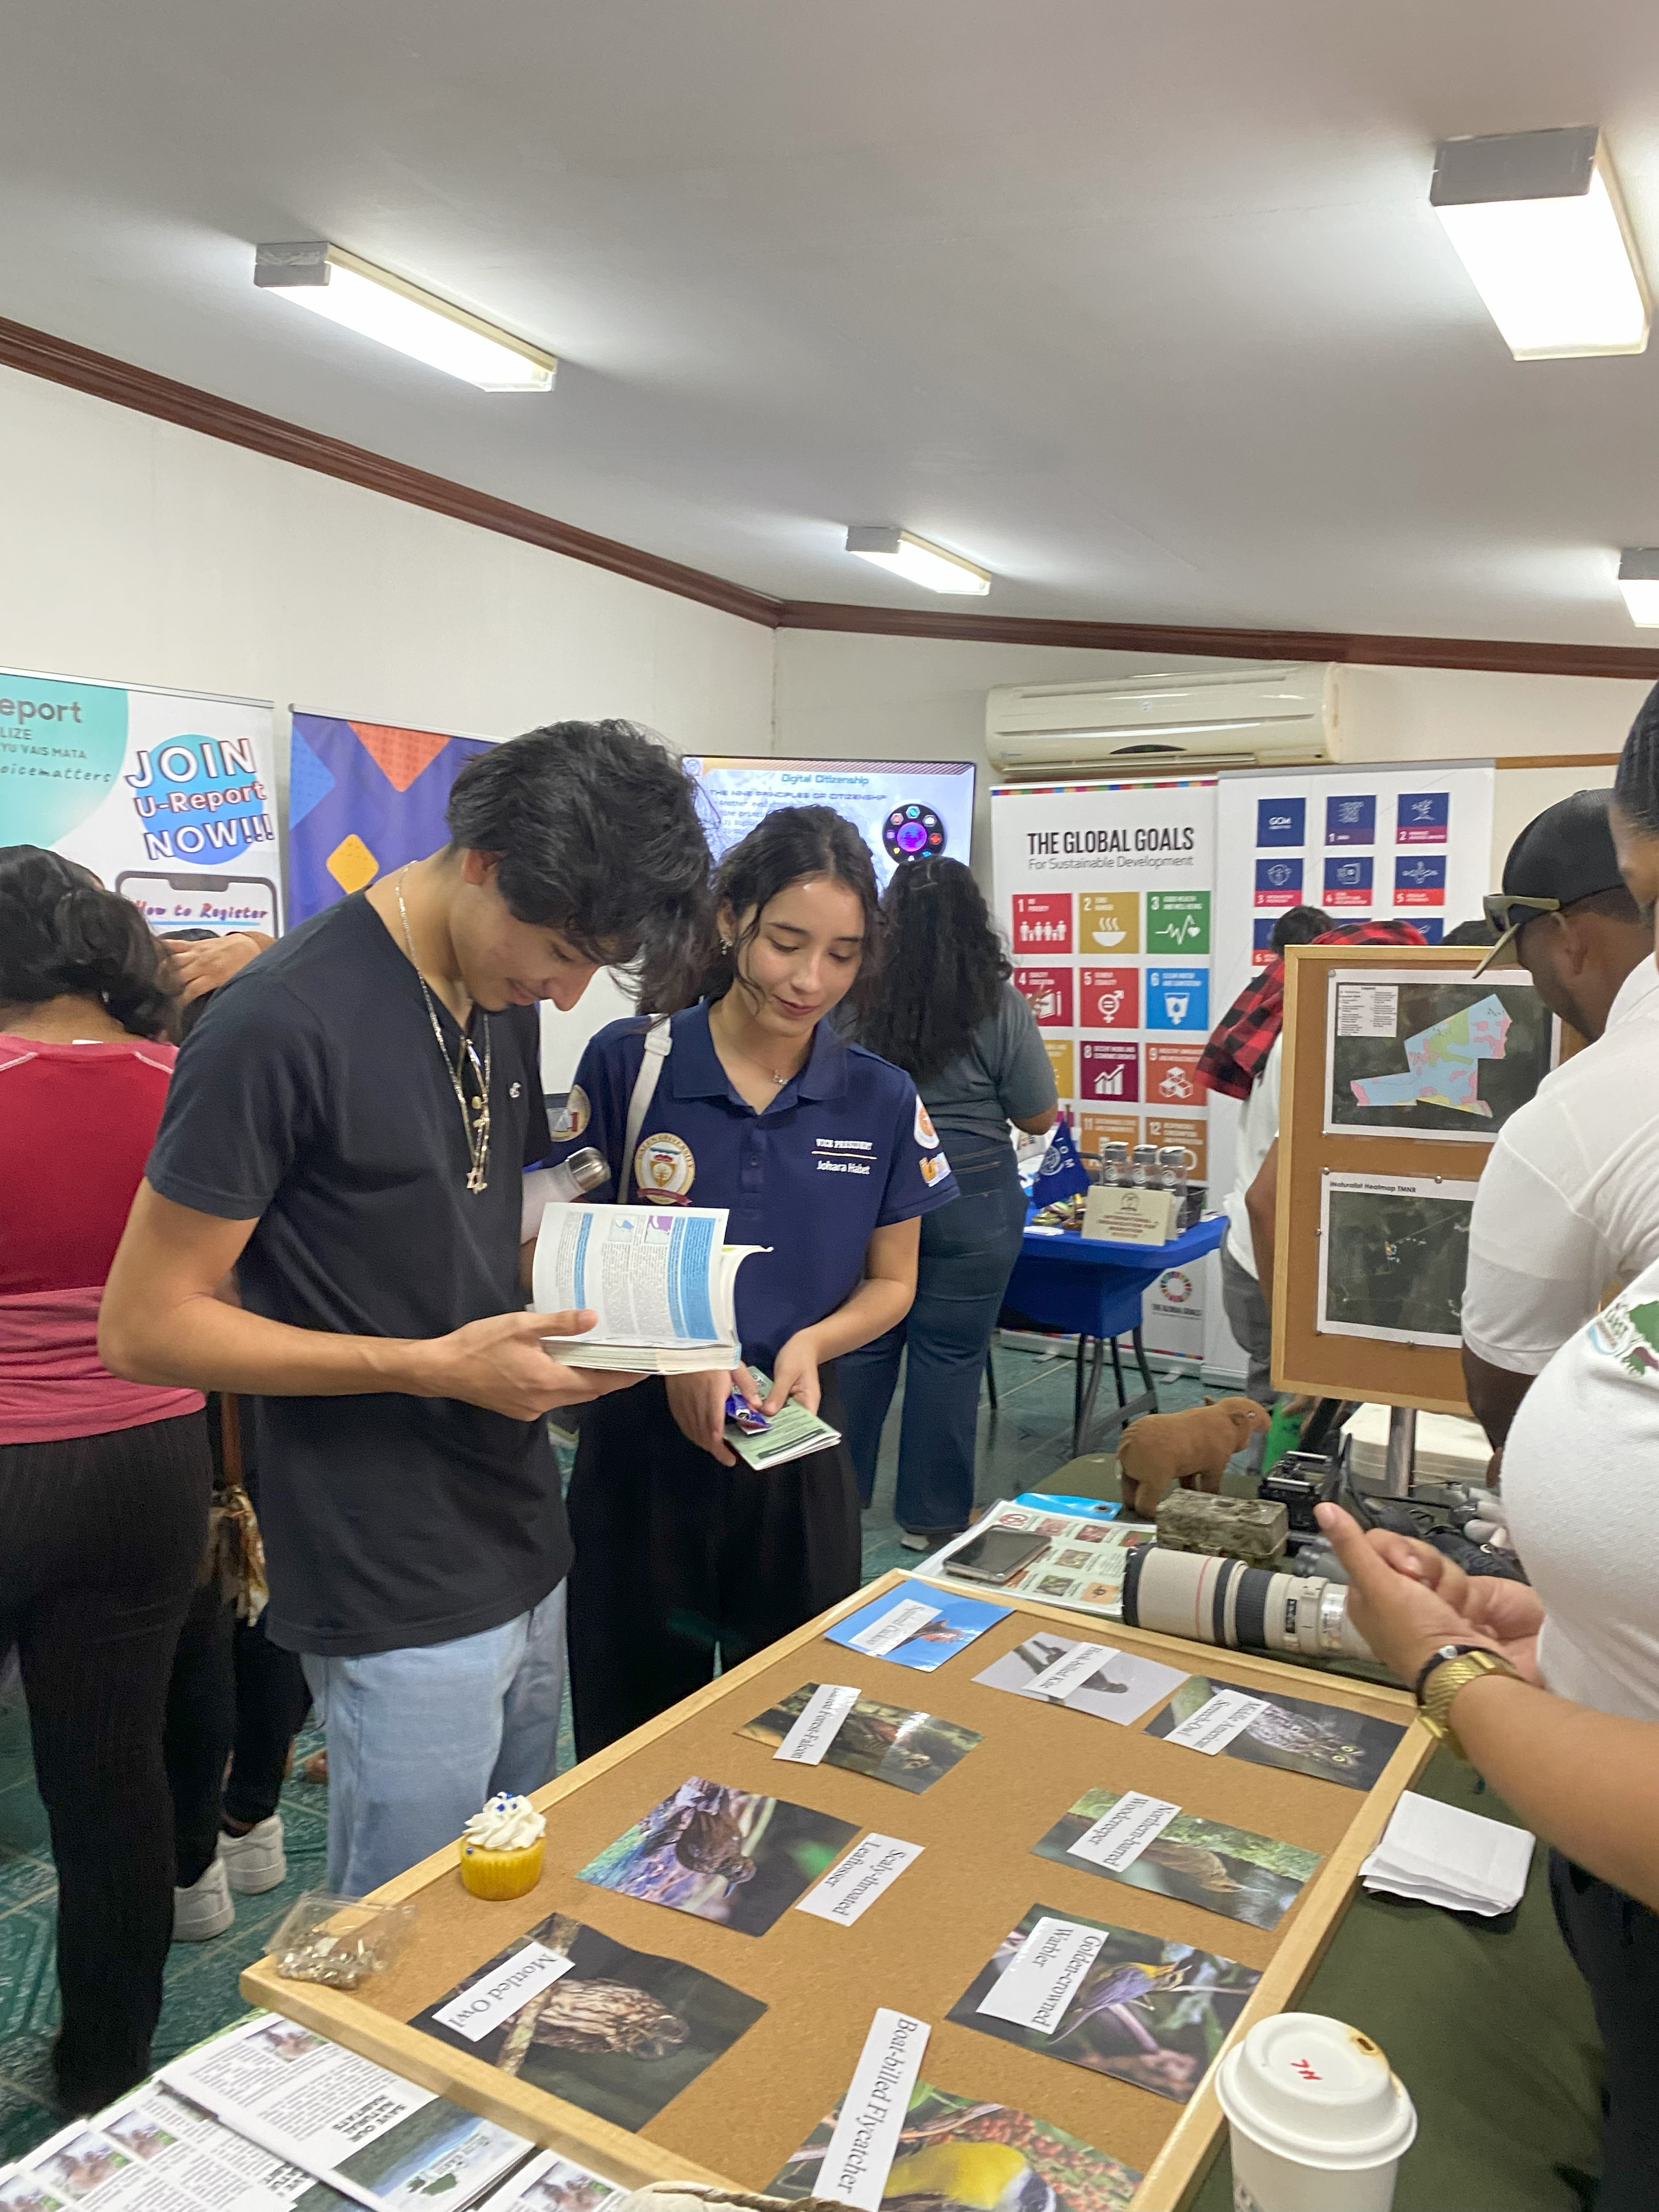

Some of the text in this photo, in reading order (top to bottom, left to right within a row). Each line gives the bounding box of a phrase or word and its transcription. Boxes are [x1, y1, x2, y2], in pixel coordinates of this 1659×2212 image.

[52, 748, 87, 759] MATA
[125, 738, 256, 788] JOIN
[781, 774, 870, 786] Digital Citizenship
[133, 781, 267, 818] U-Report
[144, 814, 275, 860] NOW!!!
[1027, 827, 1195, 855] THE GLOBAL GOALS
[1328, 833, 1335, 843] 1
[1399, 831, 1407, 841] 2
[1028, 855, 1194, 870] For Sustainable Development
[174, 905, 191, 916] to
[200, 903, 268, 921] Register
[1018, 899, 1024, 912] 1
[1084, 897, 1092, 911] 2
[1150, 896, 1160, 911] 3
[1257, 894, 1265, 904] 3
[1018, 972, 1026, 985] 4
[1084, 971, 1092, 985] 5
[1364, 1183, 1396, 1192] Heatmap
[1041, 1674, 1064, 1689] Kite
[1176, 1700, 1231, 1736] Screech-Owl
[790, 1709, 832, 1759] Forest-Falcon
[1087, 1798, 1150, 1846] Woodcreeper
[1103, 1804, 1176, 1866] Northern-barred
[824, 1841, 881, 1887] Leaftosser
[832, 1849, 906, 1916] Scaly-throated
[1032, 1929, 1074, 1968] Warbler
[447, 1953, 558, 2028] Mottled Owl
[1031, 1936, 1102, 2026] Golden-crowned
[333, 2094, 387, 2132] HABITATS
[343, 2100, 395, 2137] NATURAL
[837, 2017, 918, 2193] Boat-billed Flycatcher
[348, 2124, 376, 2143] OUR
